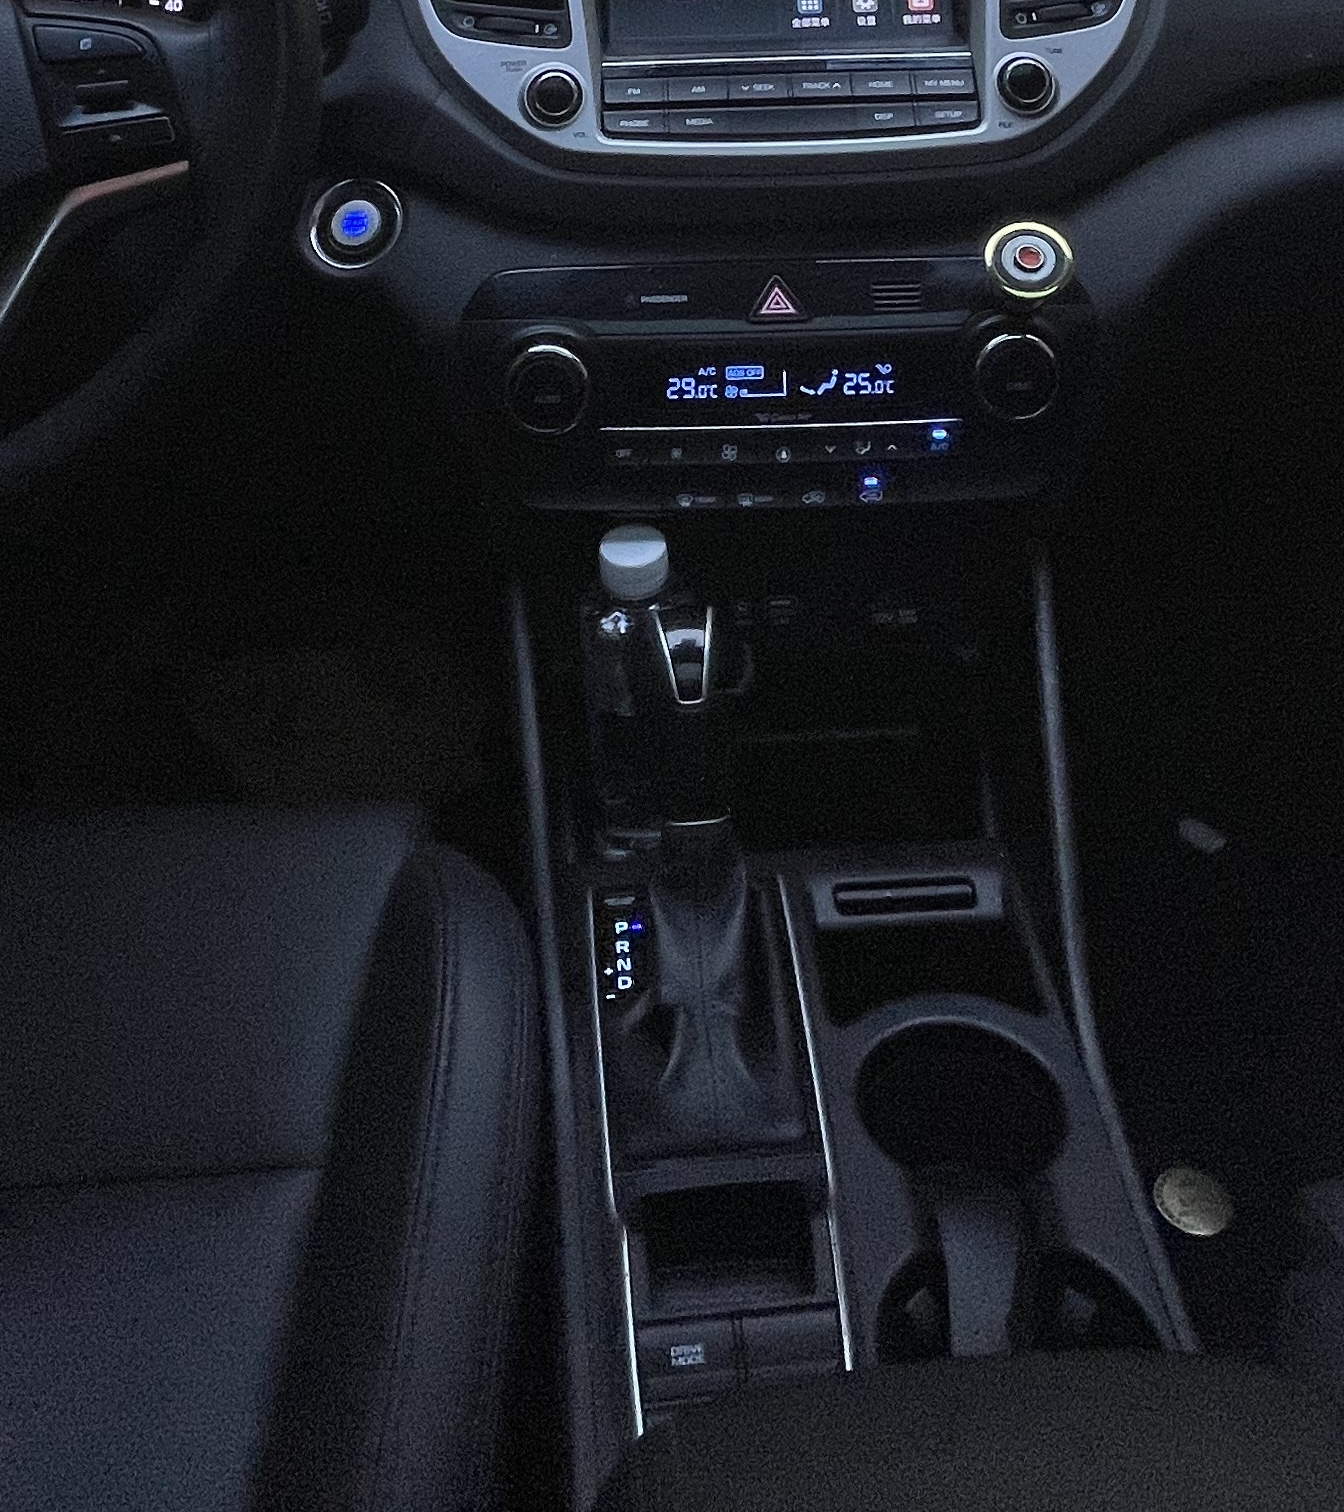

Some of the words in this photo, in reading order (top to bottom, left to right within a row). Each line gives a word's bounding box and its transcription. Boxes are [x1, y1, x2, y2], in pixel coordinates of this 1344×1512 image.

[164, 0, 183, 12] 40
[698, 367, 717, 376] A/C
[614, 921, 629, 934] P
[615, 940, 630, 954] R
[617, 957, 632, 971] N
[617, 976, 633, 990] D
